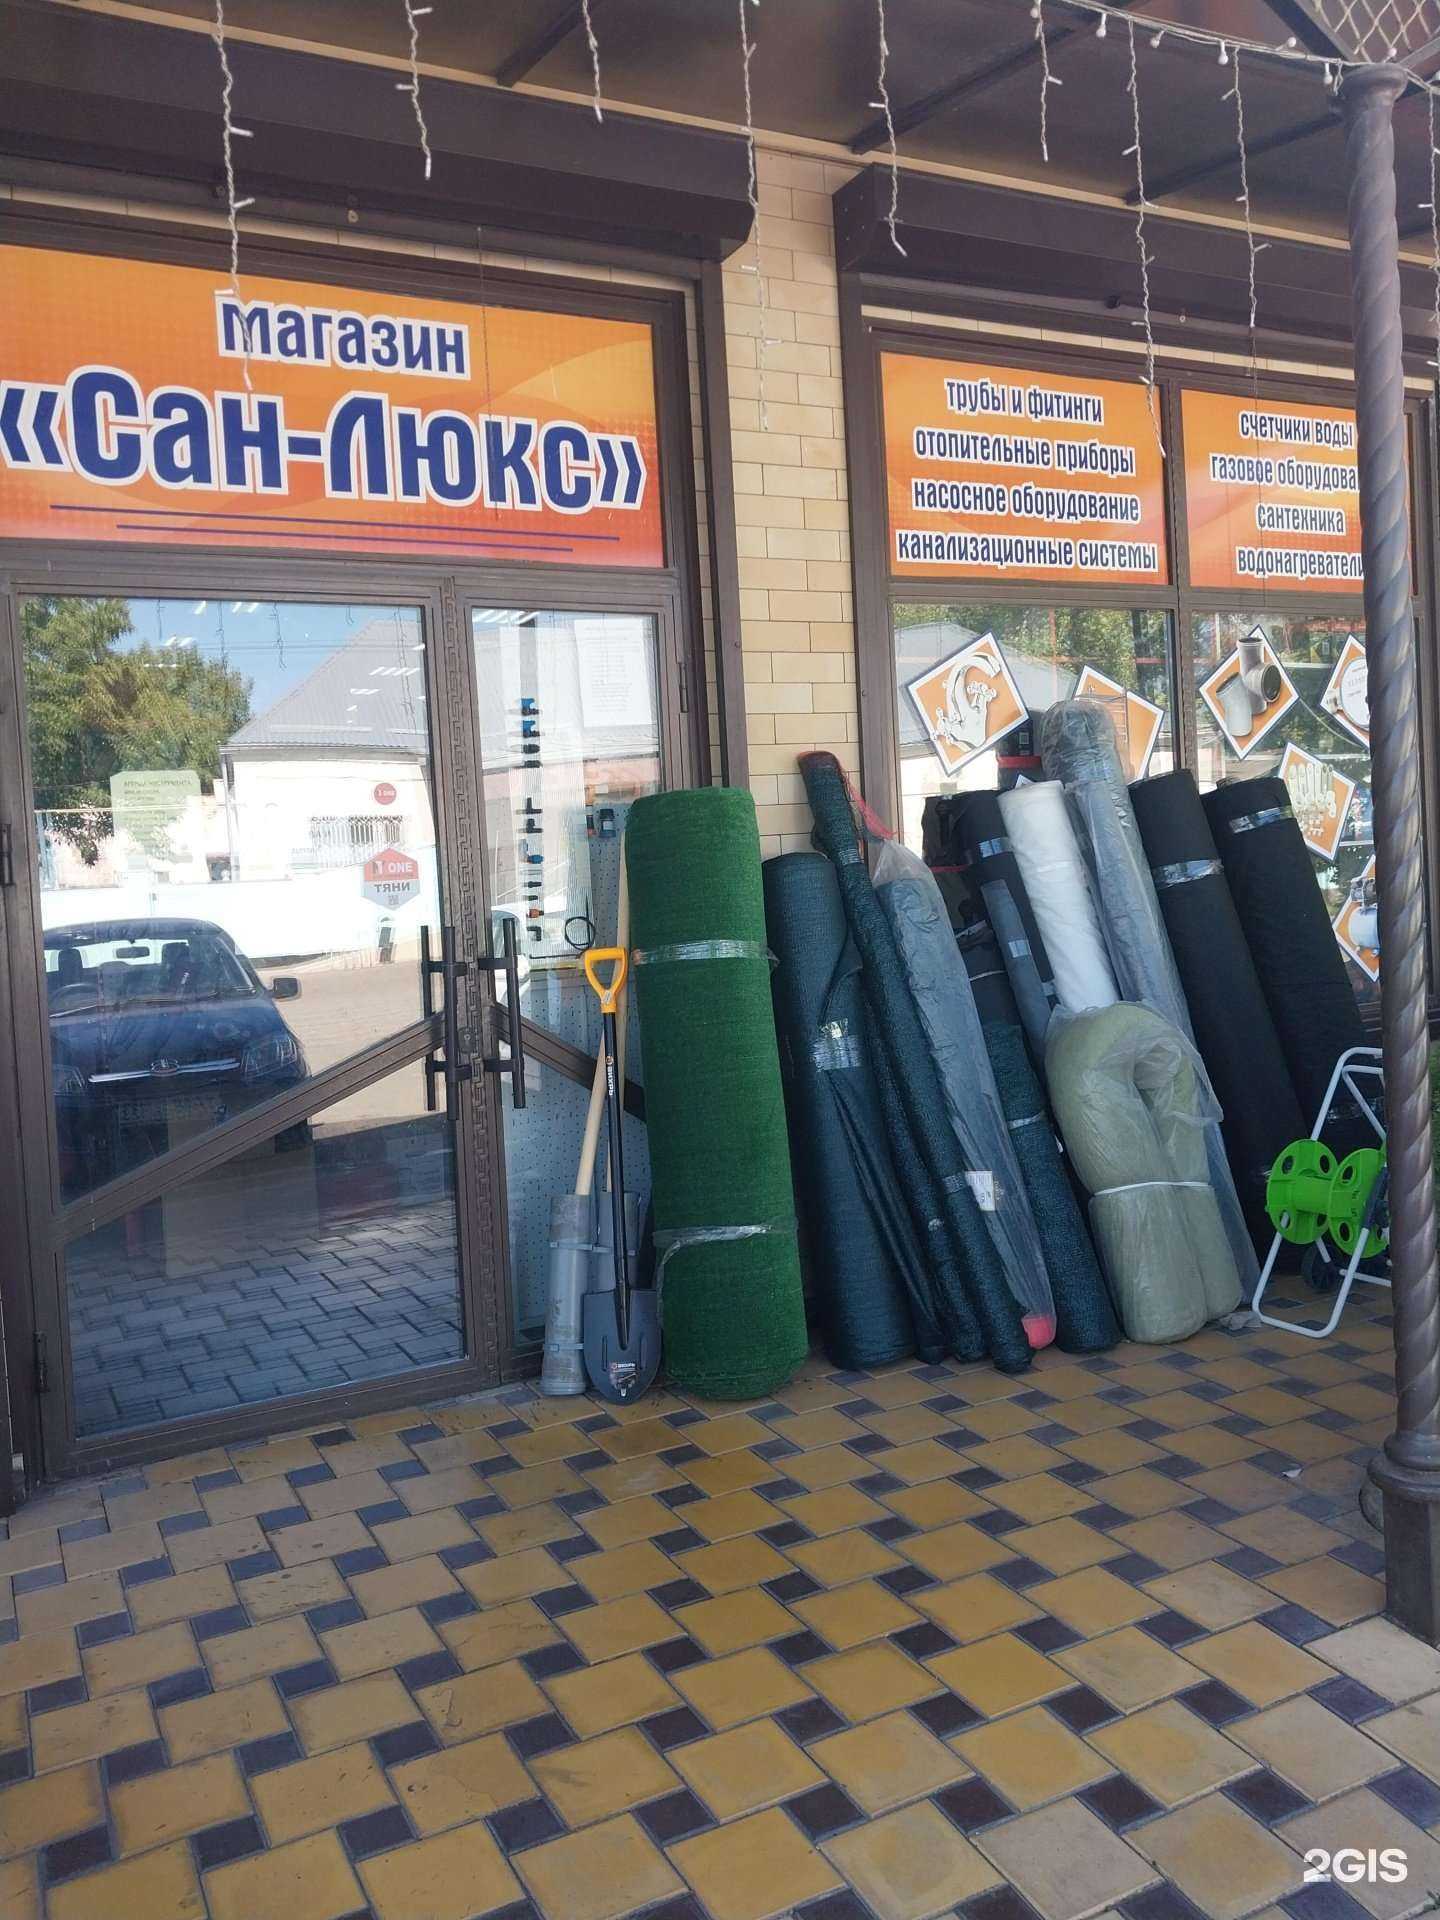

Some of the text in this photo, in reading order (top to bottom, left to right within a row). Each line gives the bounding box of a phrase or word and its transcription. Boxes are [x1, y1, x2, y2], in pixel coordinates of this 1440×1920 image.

[221, 302, 466, 375] магазин
[946, 380, 1103, 423] трубы и фитинги
[0, 371, 643, 509] «Сан-Люкс»
[1240, 412, 1353, 448] счетчики воды
[914, 428, 1135, 475] отопительные приборы
[1211, 454, 1360, 492] газовое оборудова
[913, 480, 1140, 522] насосное оборудование
[1257, 503, 1345, 533] сантехника
[897, 531, 1157, 571] канализационные системы
[373, 881, 411, 893] ТЯНИ
